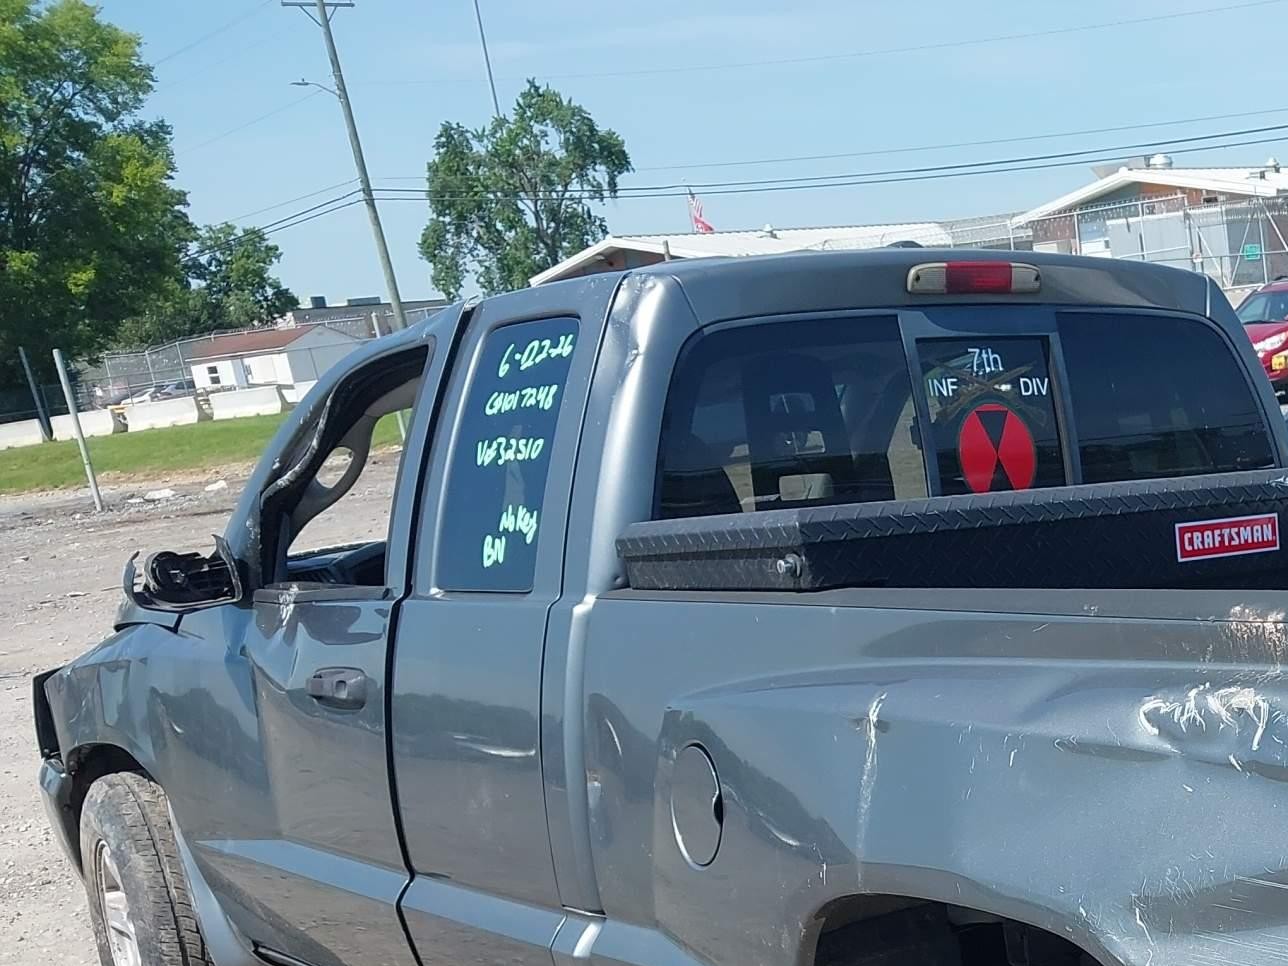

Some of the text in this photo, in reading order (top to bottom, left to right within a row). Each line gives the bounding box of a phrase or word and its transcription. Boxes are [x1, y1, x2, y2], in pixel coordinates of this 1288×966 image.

[967, 347, 1004, 374] 7th
[928, 377, 1049, 397] INF DIV
